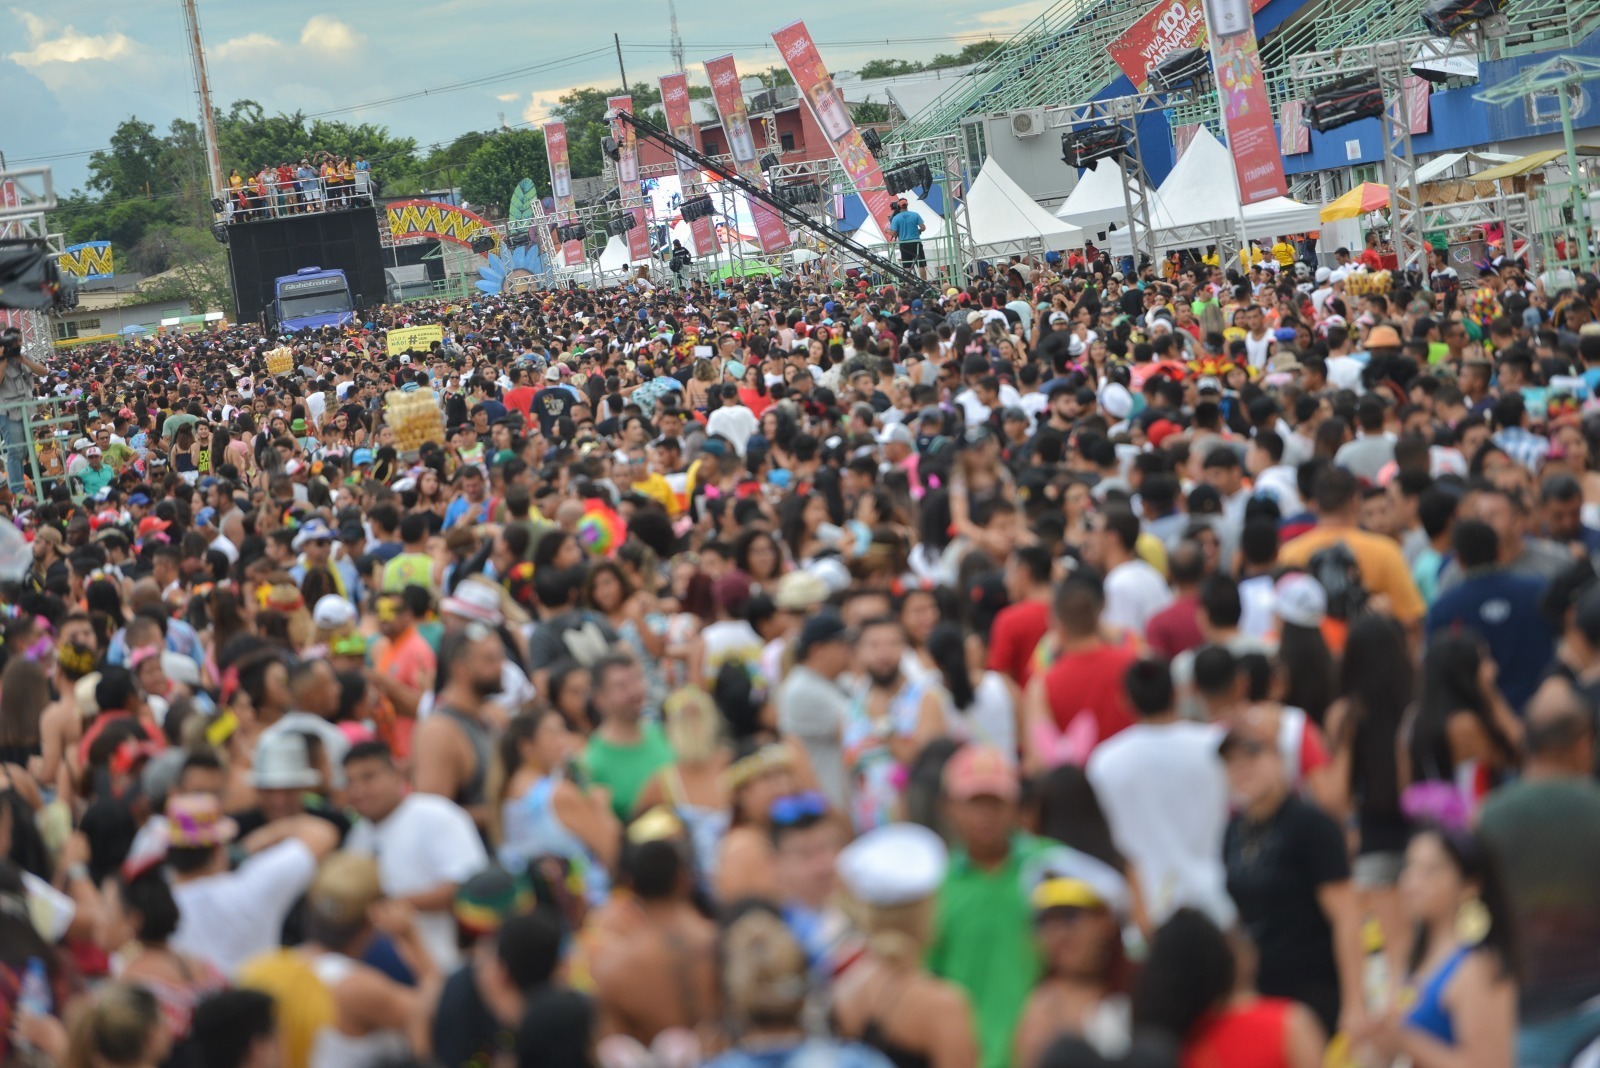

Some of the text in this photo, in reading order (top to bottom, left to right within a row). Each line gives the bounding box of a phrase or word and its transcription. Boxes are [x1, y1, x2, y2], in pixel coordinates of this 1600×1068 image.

[1142, 2, 1186, 59] VIVA 100
[1146, 6, 1202, 72] CARNAVAIS
[1244, 161, 1275, 183] ITAIPAVA
[285, 279, 337, 291] Globetrotter
